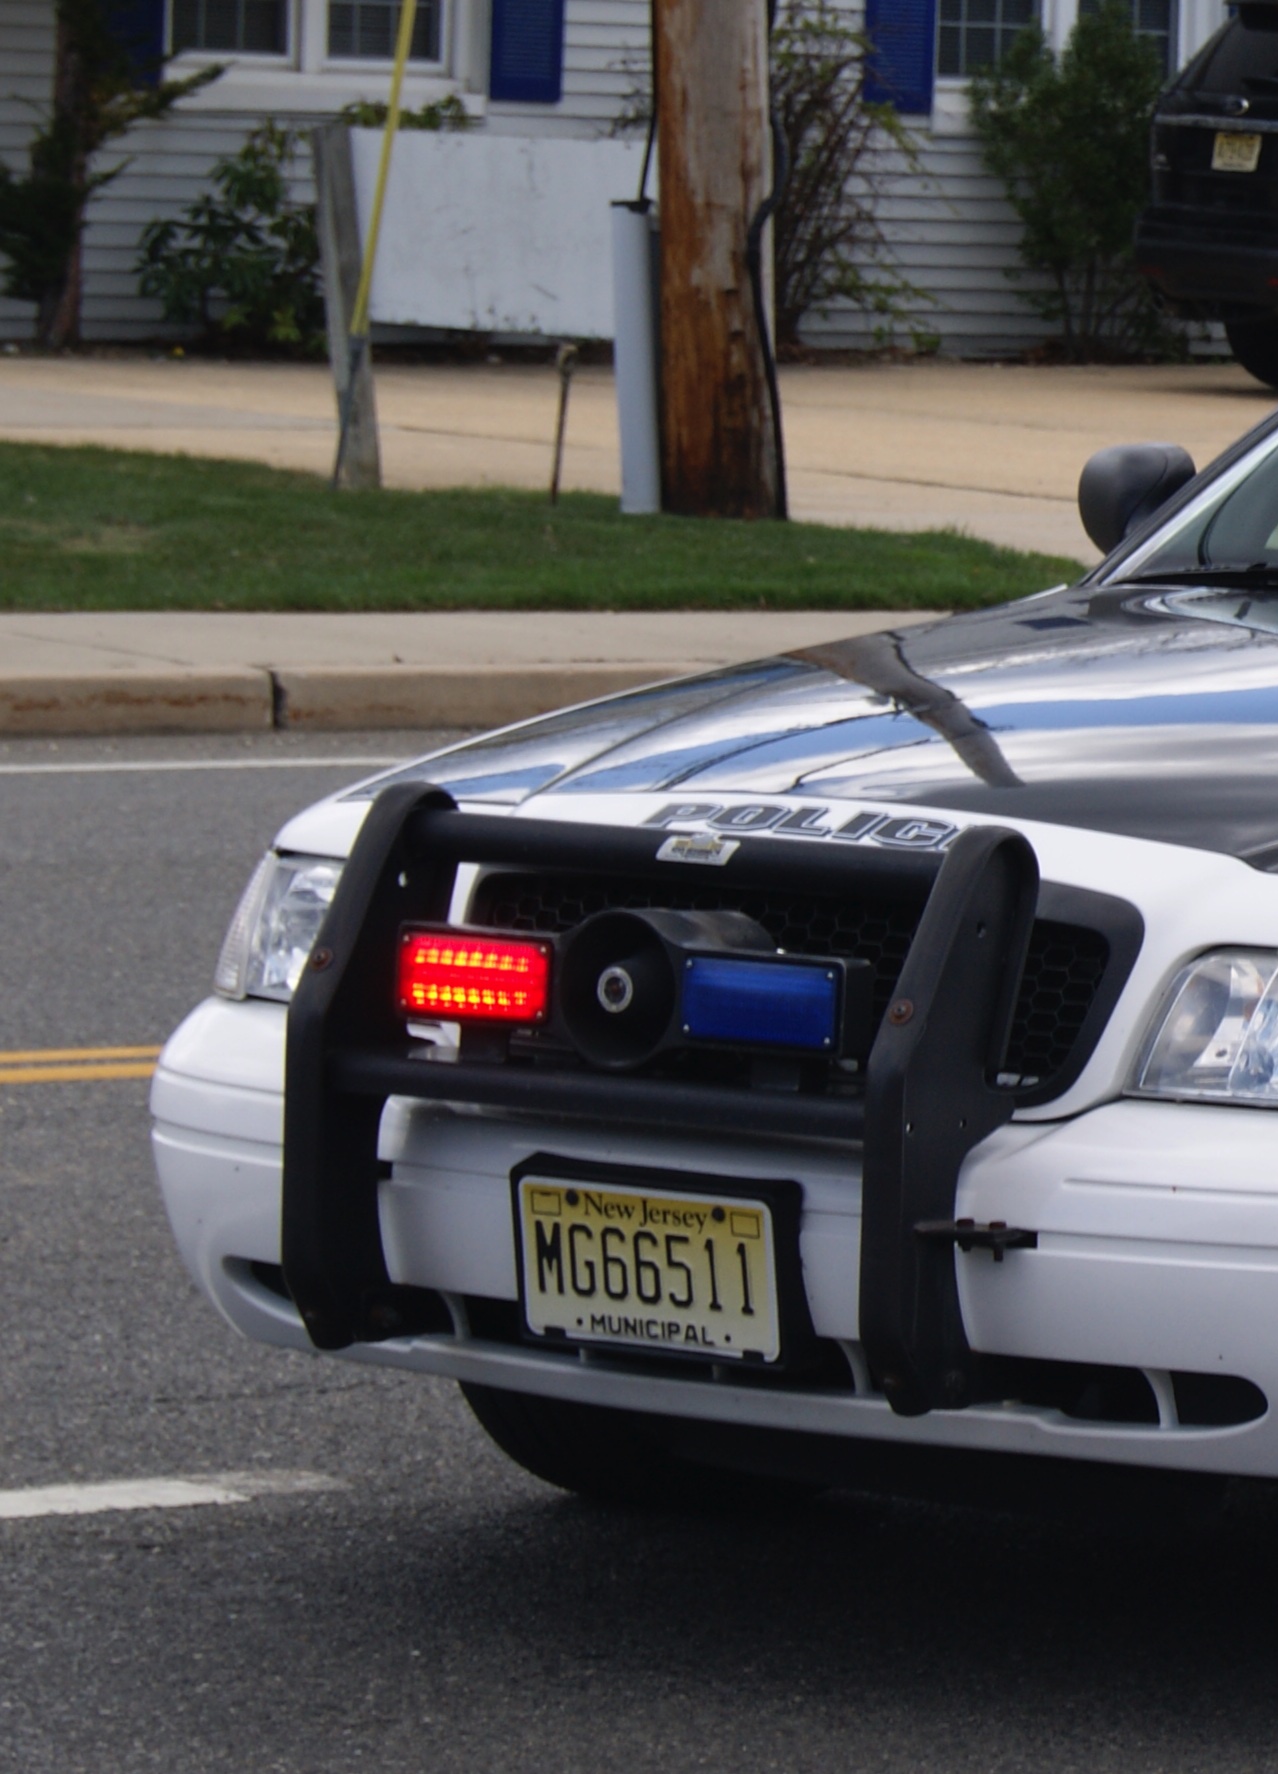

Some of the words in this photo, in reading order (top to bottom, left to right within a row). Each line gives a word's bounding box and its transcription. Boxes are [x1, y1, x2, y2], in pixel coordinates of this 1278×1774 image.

[640, 803, 975, 851] POLIC
[584, 1191, 635, 1221] New
[639, 1198, 709, 1234] Jersey
[534, 1219, 755, 1317] MG66511
[589, 1313, 716, 1346] MUNICIPAL
